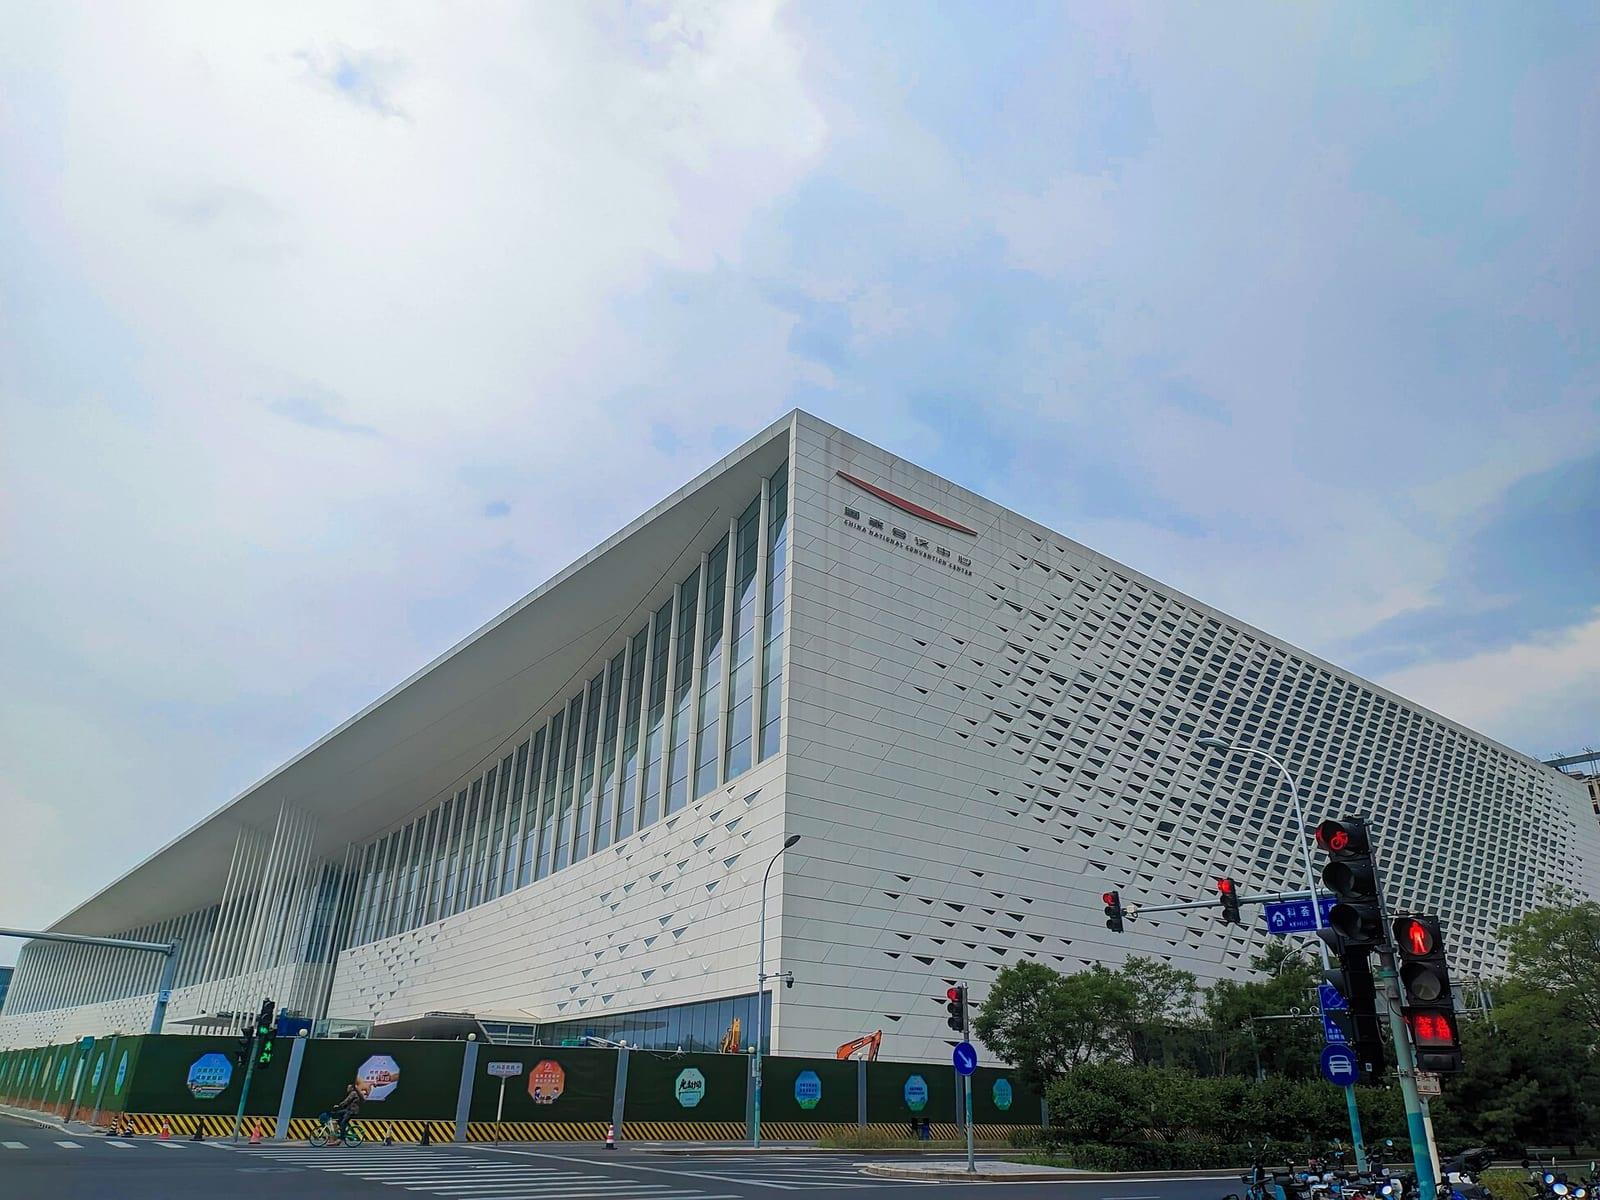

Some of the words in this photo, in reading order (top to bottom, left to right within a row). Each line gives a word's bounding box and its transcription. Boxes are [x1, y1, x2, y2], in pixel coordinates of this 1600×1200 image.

[844, 519, 867, 533] CHINA
[868, 529, 904, 549] NATIONAL
[905, 544, 948, 567] CONVENTION
[949, 562, 973, 576] CENTER
